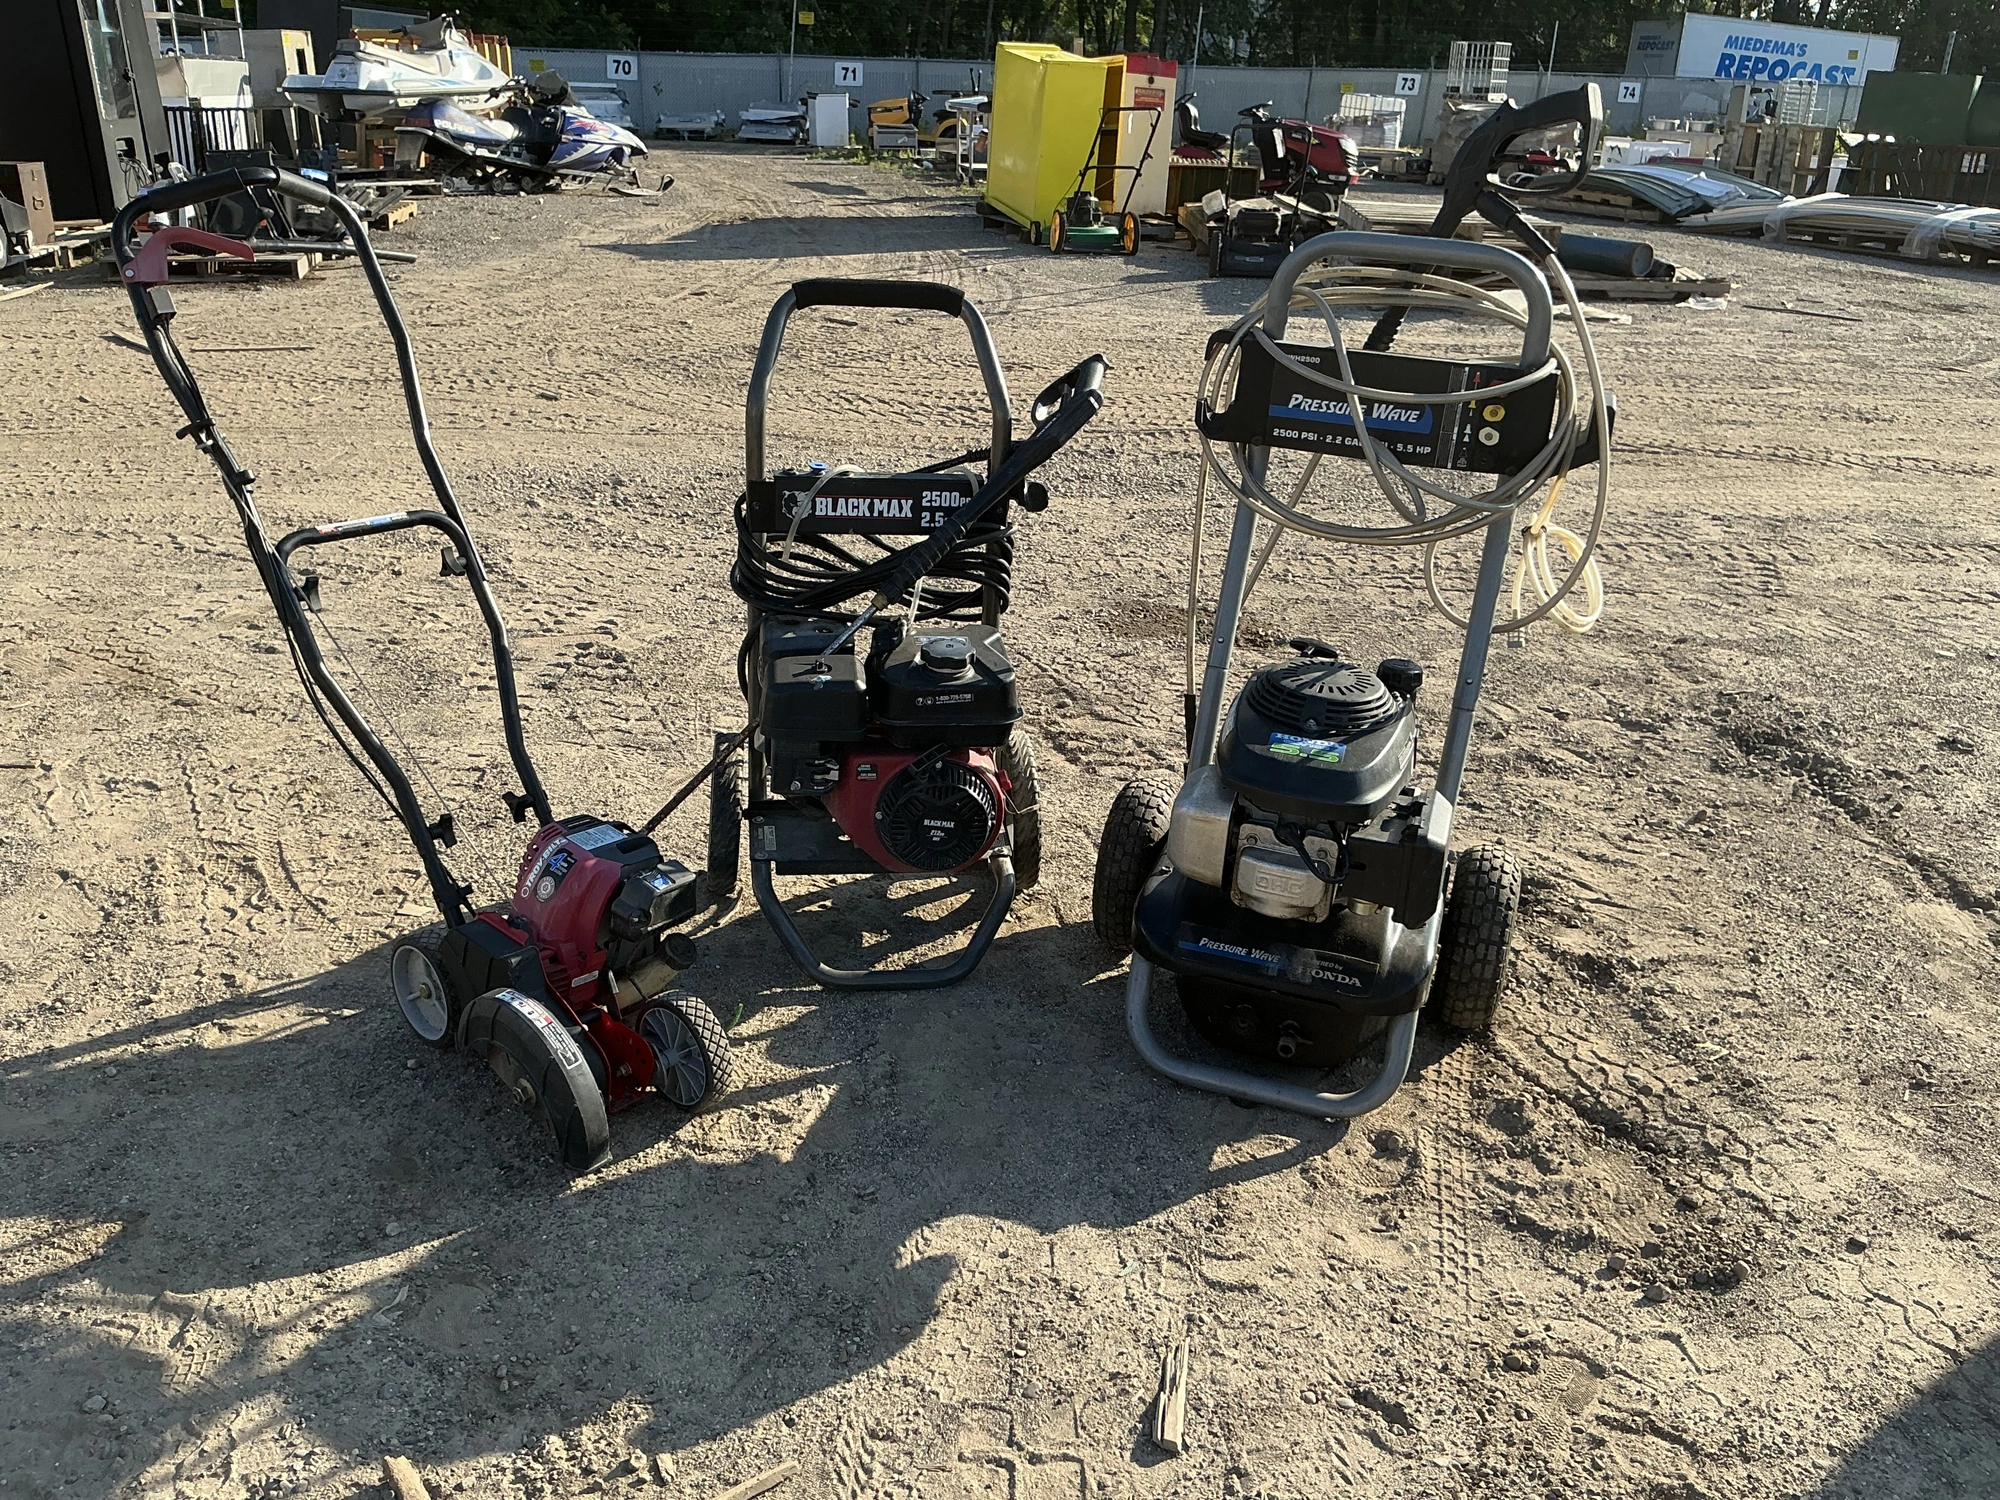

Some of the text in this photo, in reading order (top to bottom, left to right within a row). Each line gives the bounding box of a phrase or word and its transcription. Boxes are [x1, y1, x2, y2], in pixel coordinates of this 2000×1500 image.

[1723, 34, 1808, 57] MIEDEMA'S
[612, 59, 632, 75] 70
[841, 66, 857, 81] 71
[1714, 52, 1856, 85] REPOCAST
[1401, 77, 1416, 91] 73
[1623, 86, 1636, 99] 74
[1287, 354, 1321, 364] WH2500
[1372, 402, 1421, 423] WAVE
[1272, 428, 1299, 439] 2500
[1301, 433, 1318, 441] PSI
[1325, 434, 1342, 444] 2.2
[1396, 443, 1413, 453] 5.5
[1416, 446, 1432, 455] HP
[815, 497, 913, 518] BLACK MAX
[920, 512, 949, 527] 2.5
[1269, 743, 1339, 763] 5.5
[923, 819, 941, 827] BLACK
[1199, 937, 1281, 963] PRESSURE WAVE
[1310, 968, 1363, 988] ONDA
